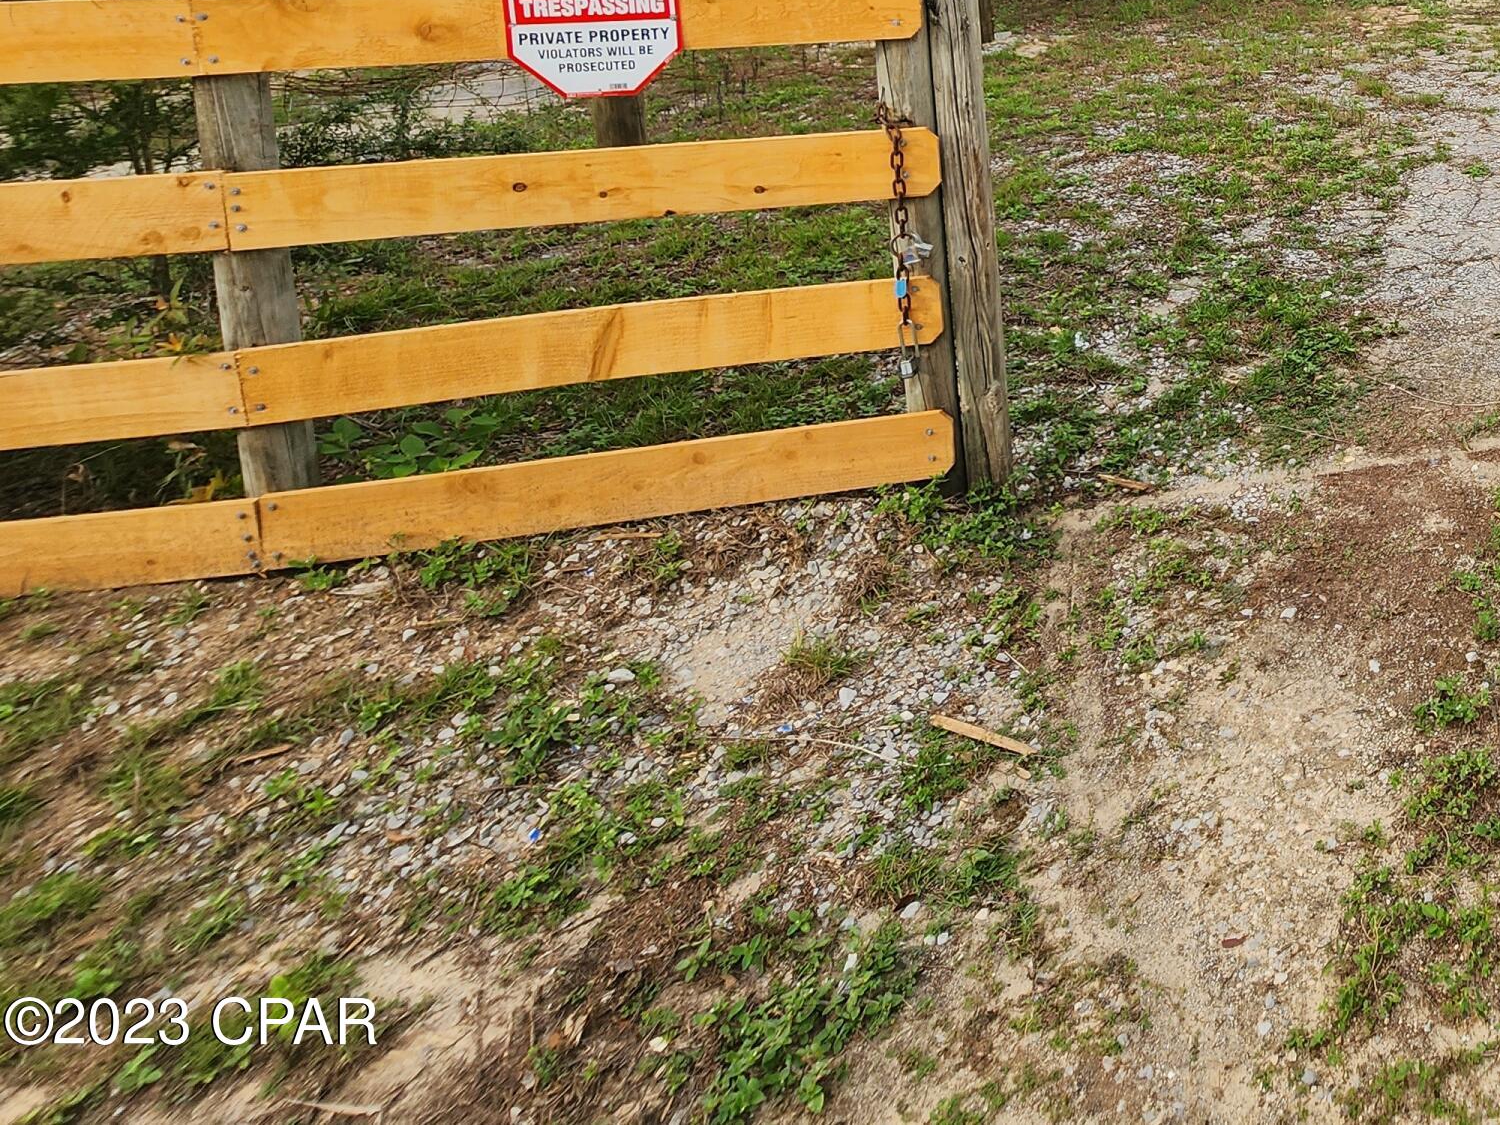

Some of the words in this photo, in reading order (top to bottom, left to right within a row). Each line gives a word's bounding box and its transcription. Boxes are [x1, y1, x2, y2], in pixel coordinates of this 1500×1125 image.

[518, 31, 583, 45] PRIVATE
[589, 27, 670, 43] PROPERTY
[538, 47, 603, 59] VIOLATORS
[607, 46, 635, 56] WILL
[639, 45, 653, 55] BE
[559, 60, 636, 73] PROSECUTED
